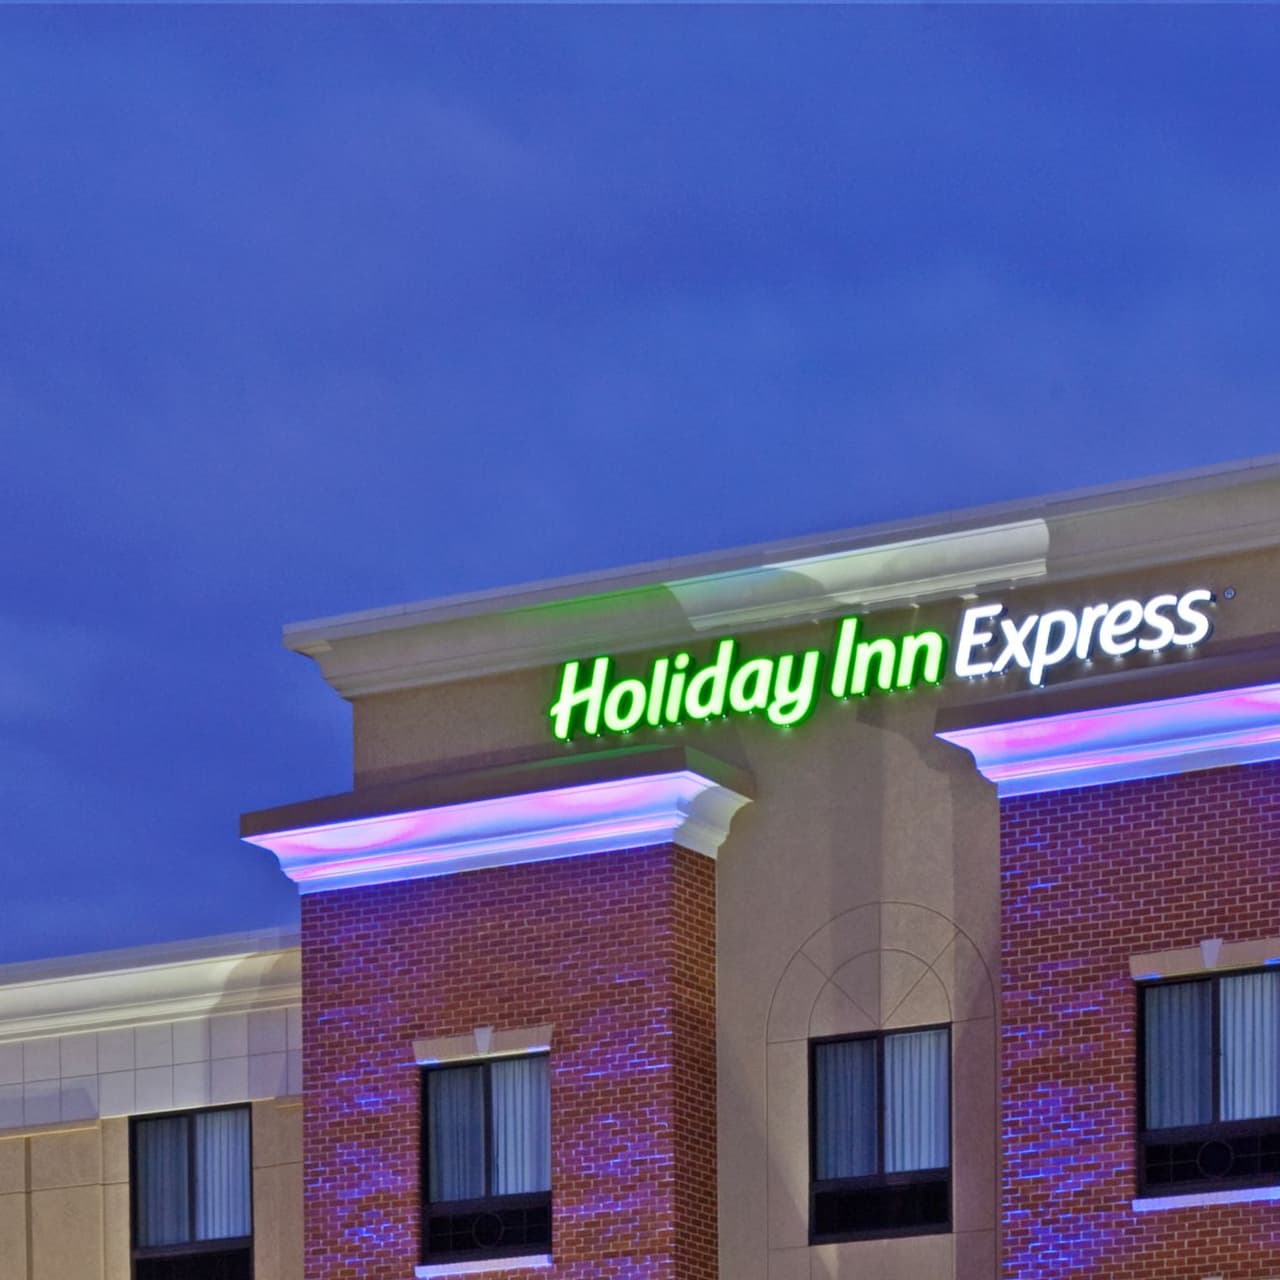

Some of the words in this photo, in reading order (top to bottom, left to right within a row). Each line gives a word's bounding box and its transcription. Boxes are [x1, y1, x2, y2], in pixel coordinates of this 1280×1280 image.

[549, 640, 820, 742] Holiday
[831, 616, 944, 699] Inn
[954, 588, 1213, 687] Express
